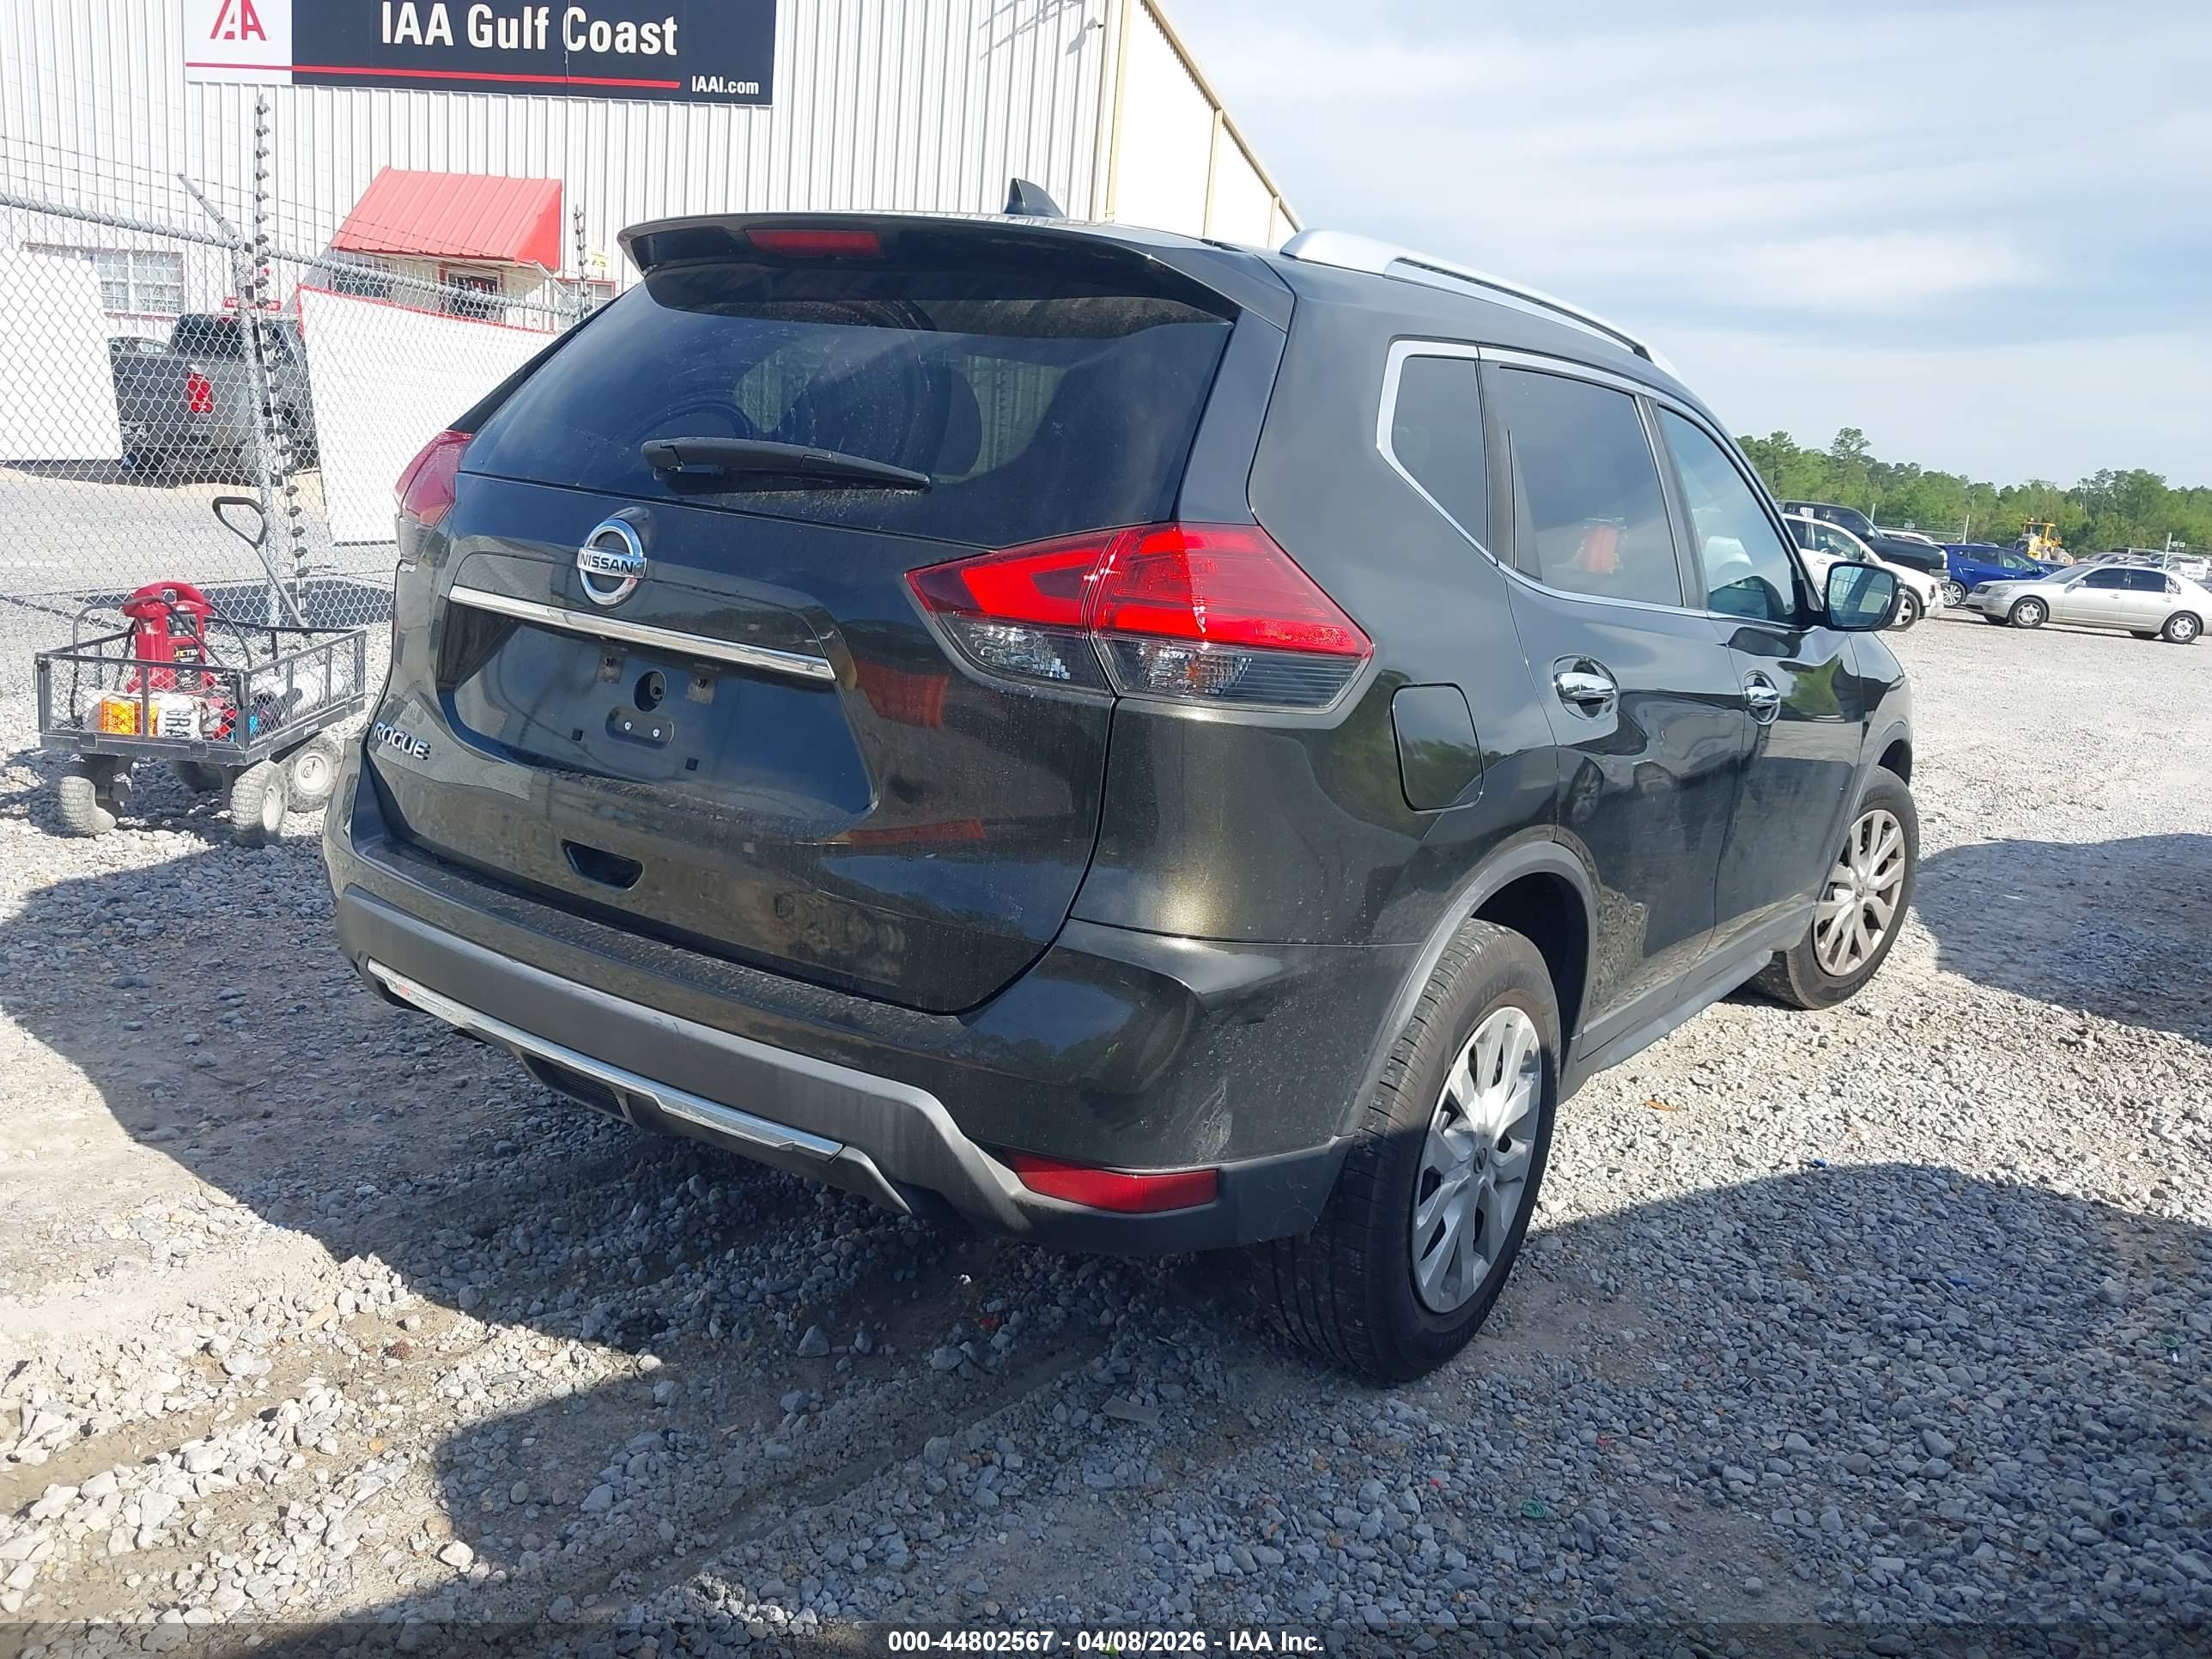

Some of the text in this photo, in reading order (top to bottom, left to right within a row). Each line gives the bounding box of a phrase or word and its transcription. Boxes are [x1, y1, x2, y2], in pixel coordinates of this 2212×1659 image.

[382, 1, 678, 56] IAA Gulf Coast
[691, 75, 759, 94] IAAI.com
[580, 551, 635, 573] NISSAN
[374, 721, 431, 761] ROGUE
